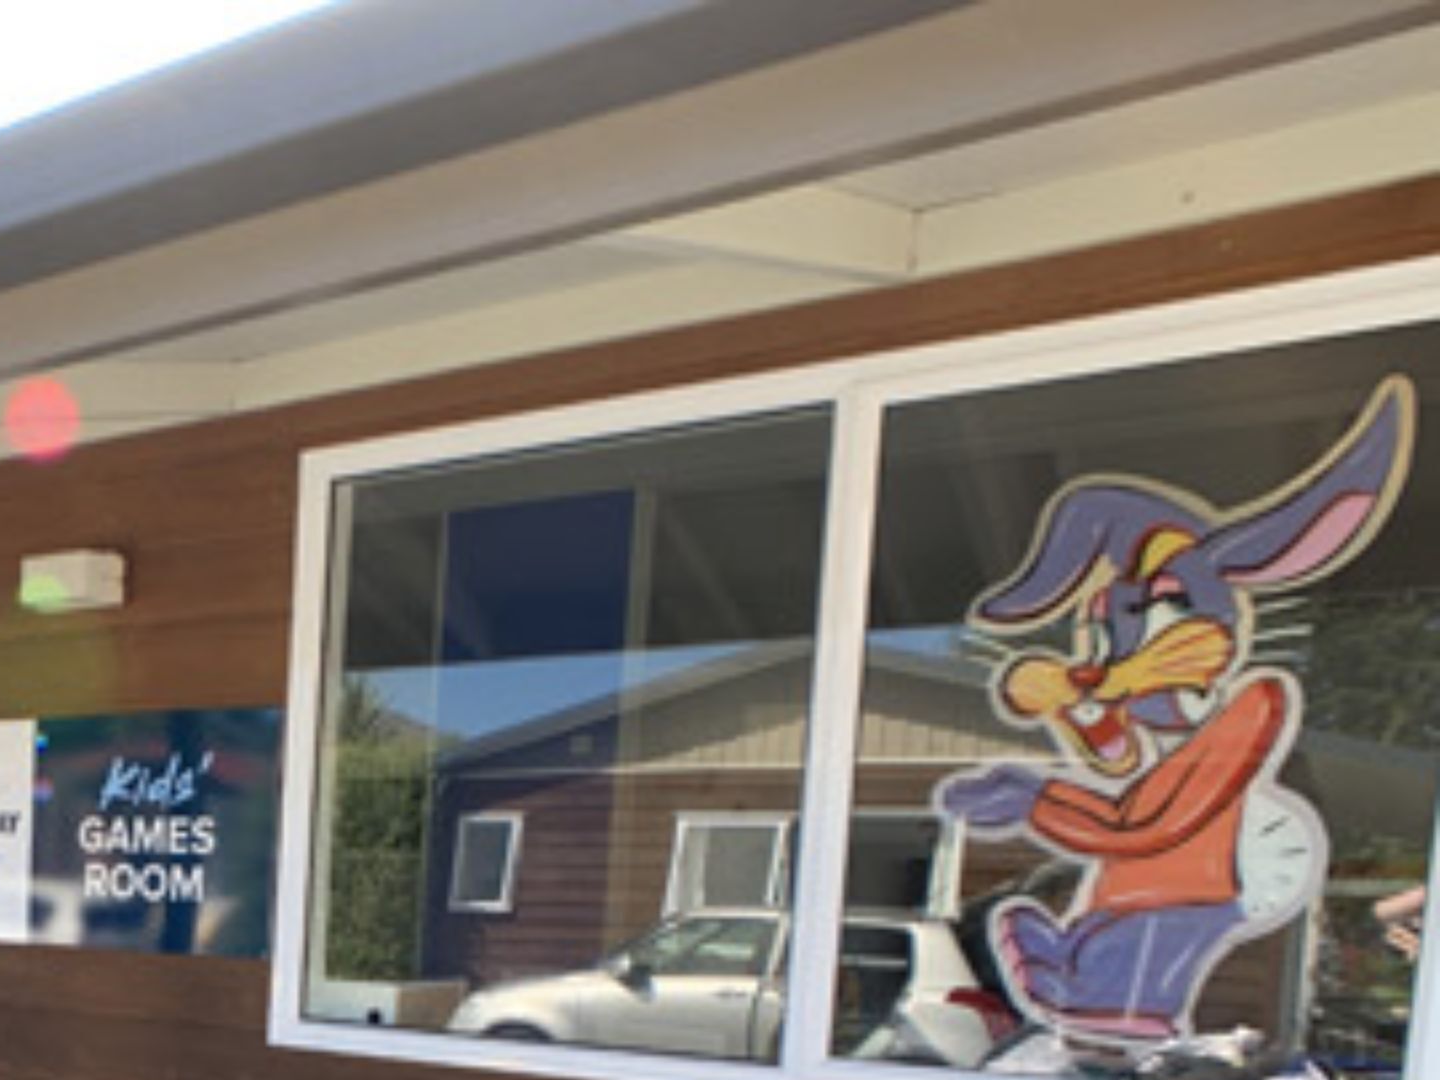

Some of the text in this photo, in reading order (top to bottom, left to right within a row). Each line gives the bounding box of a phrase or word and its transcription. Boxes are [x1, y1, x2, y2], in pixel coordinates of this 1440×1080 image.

[98, 752, 214, 811] Kids'
[78, 815, 216, 855] GAMES
[83, 862, 205, 901] ROOM
